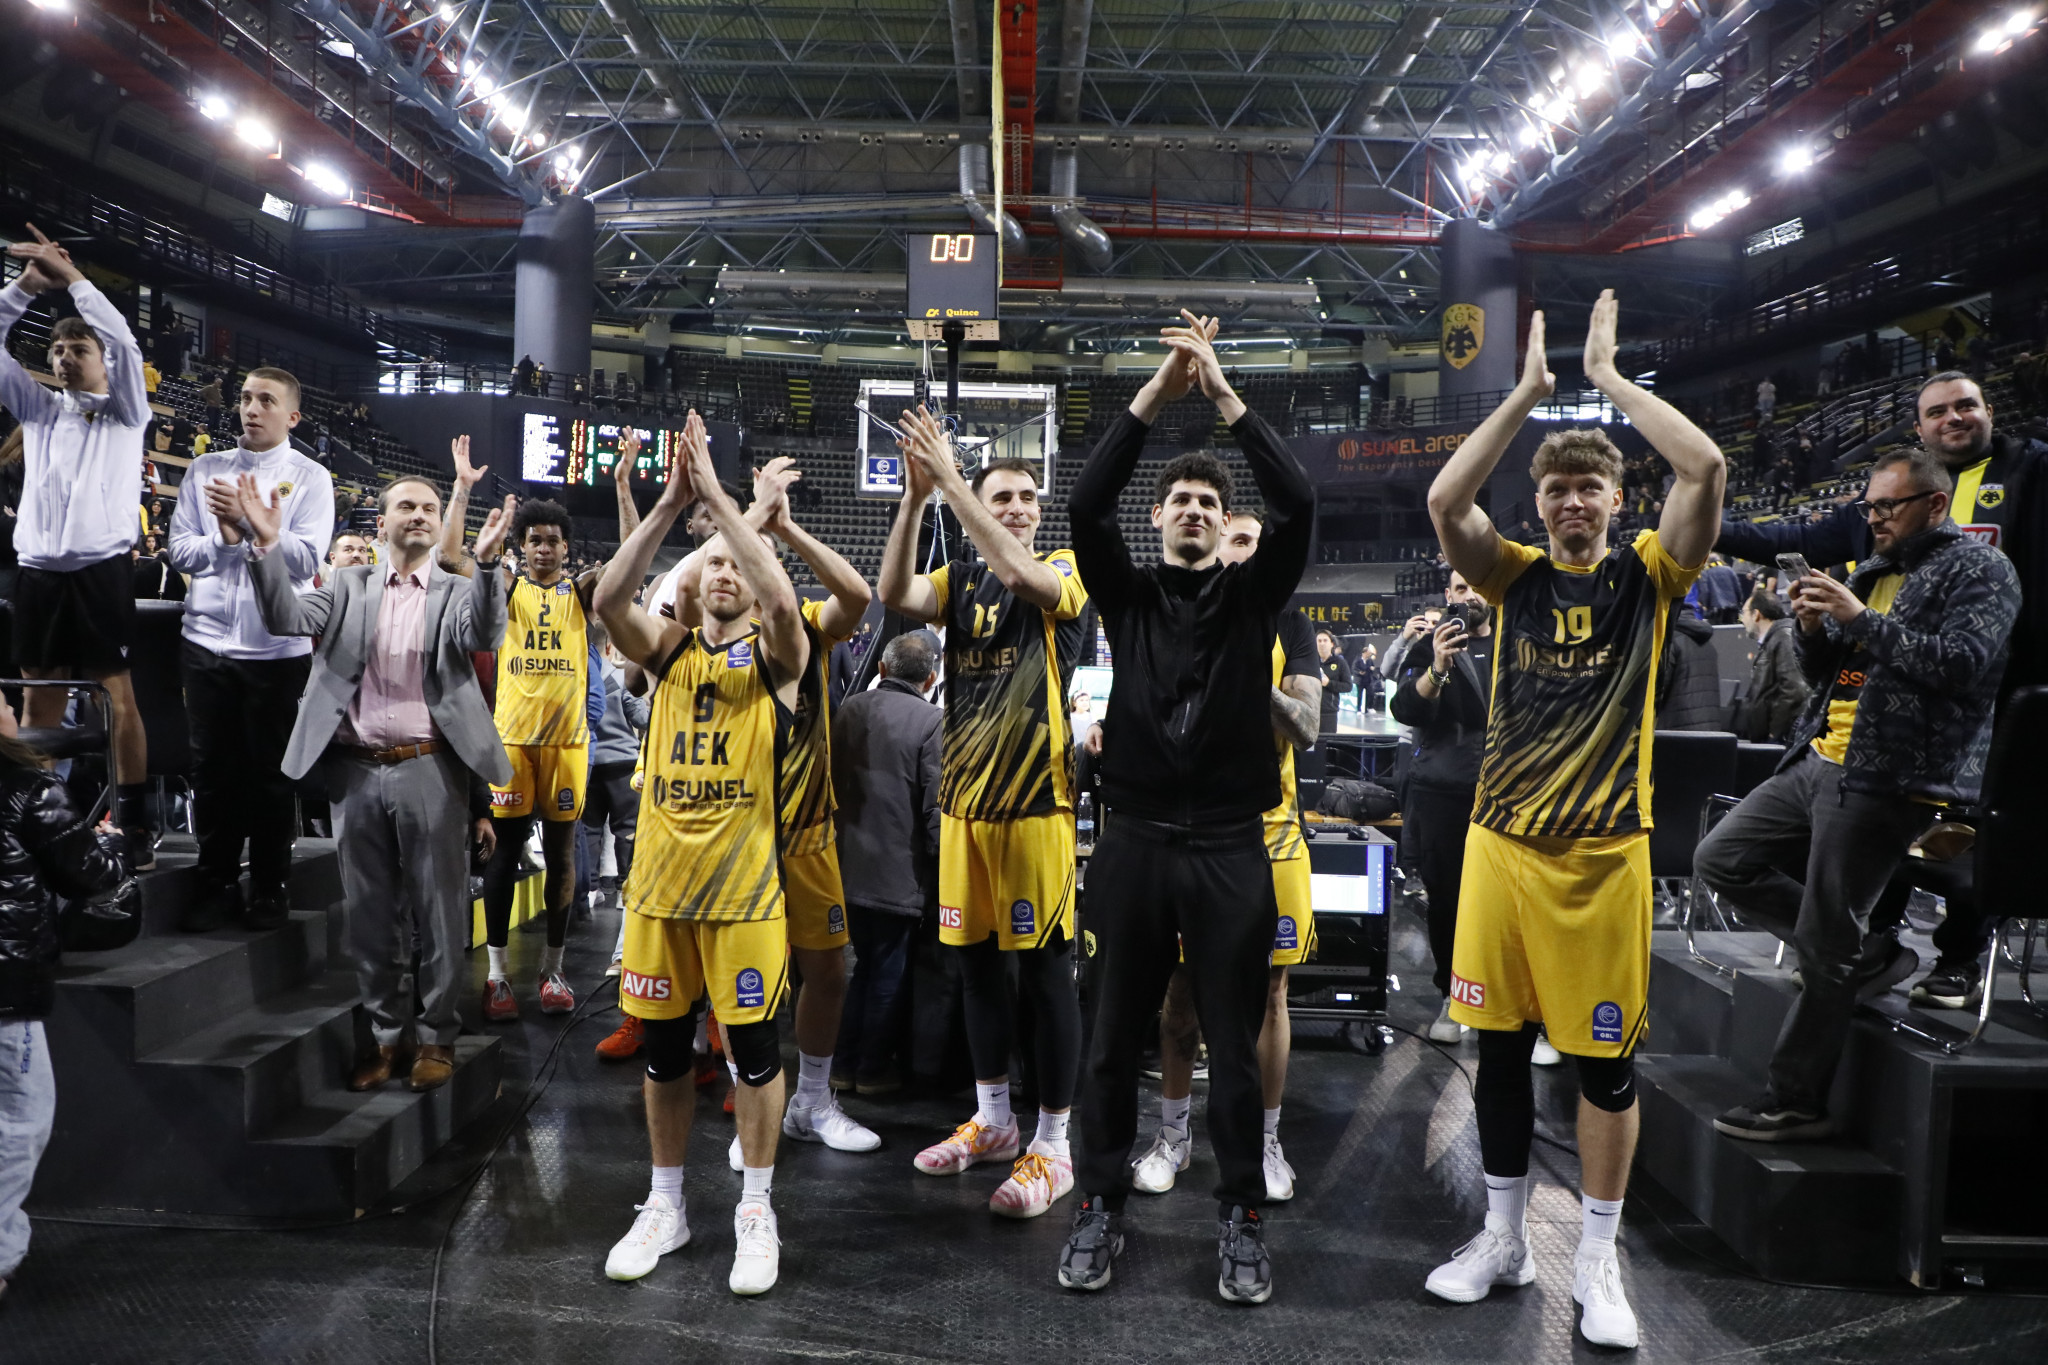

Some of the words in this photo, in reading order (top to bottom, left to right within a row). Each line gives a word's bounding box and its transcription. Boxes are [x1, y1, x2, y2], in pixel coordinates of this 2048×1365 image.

[931, 234, 974, 261] 0:0
[946, 308, 979, 317] Quince
[599, 424, 620, 437] AEK
[1362, 438, 1422, 457] SUNEL
[1425, 434, 1469, 452] aren
[601, 466, 608, 474] 4
[640, 469, 647, 478] 5
[538, 603, 550, 626] 2
[972, 602, 1000, 638] 15
[1551, 605, 1592, 645] 19
[524, 630, 562, 650] AEK
[525, 658, 575, 671] SUNEL
[693, 682, 716, 722] 9
[670, 731, 731, 765] AEK
[492, 792, 522, 805] AVIS
[670, 779, 754, 800] SUNEL
[670, 802, 721, 810] Empowering
[723, 800, 754, 808] Change
[939, 906, 960, 927] VIS
[623, 971, 670, 999] AVIS
